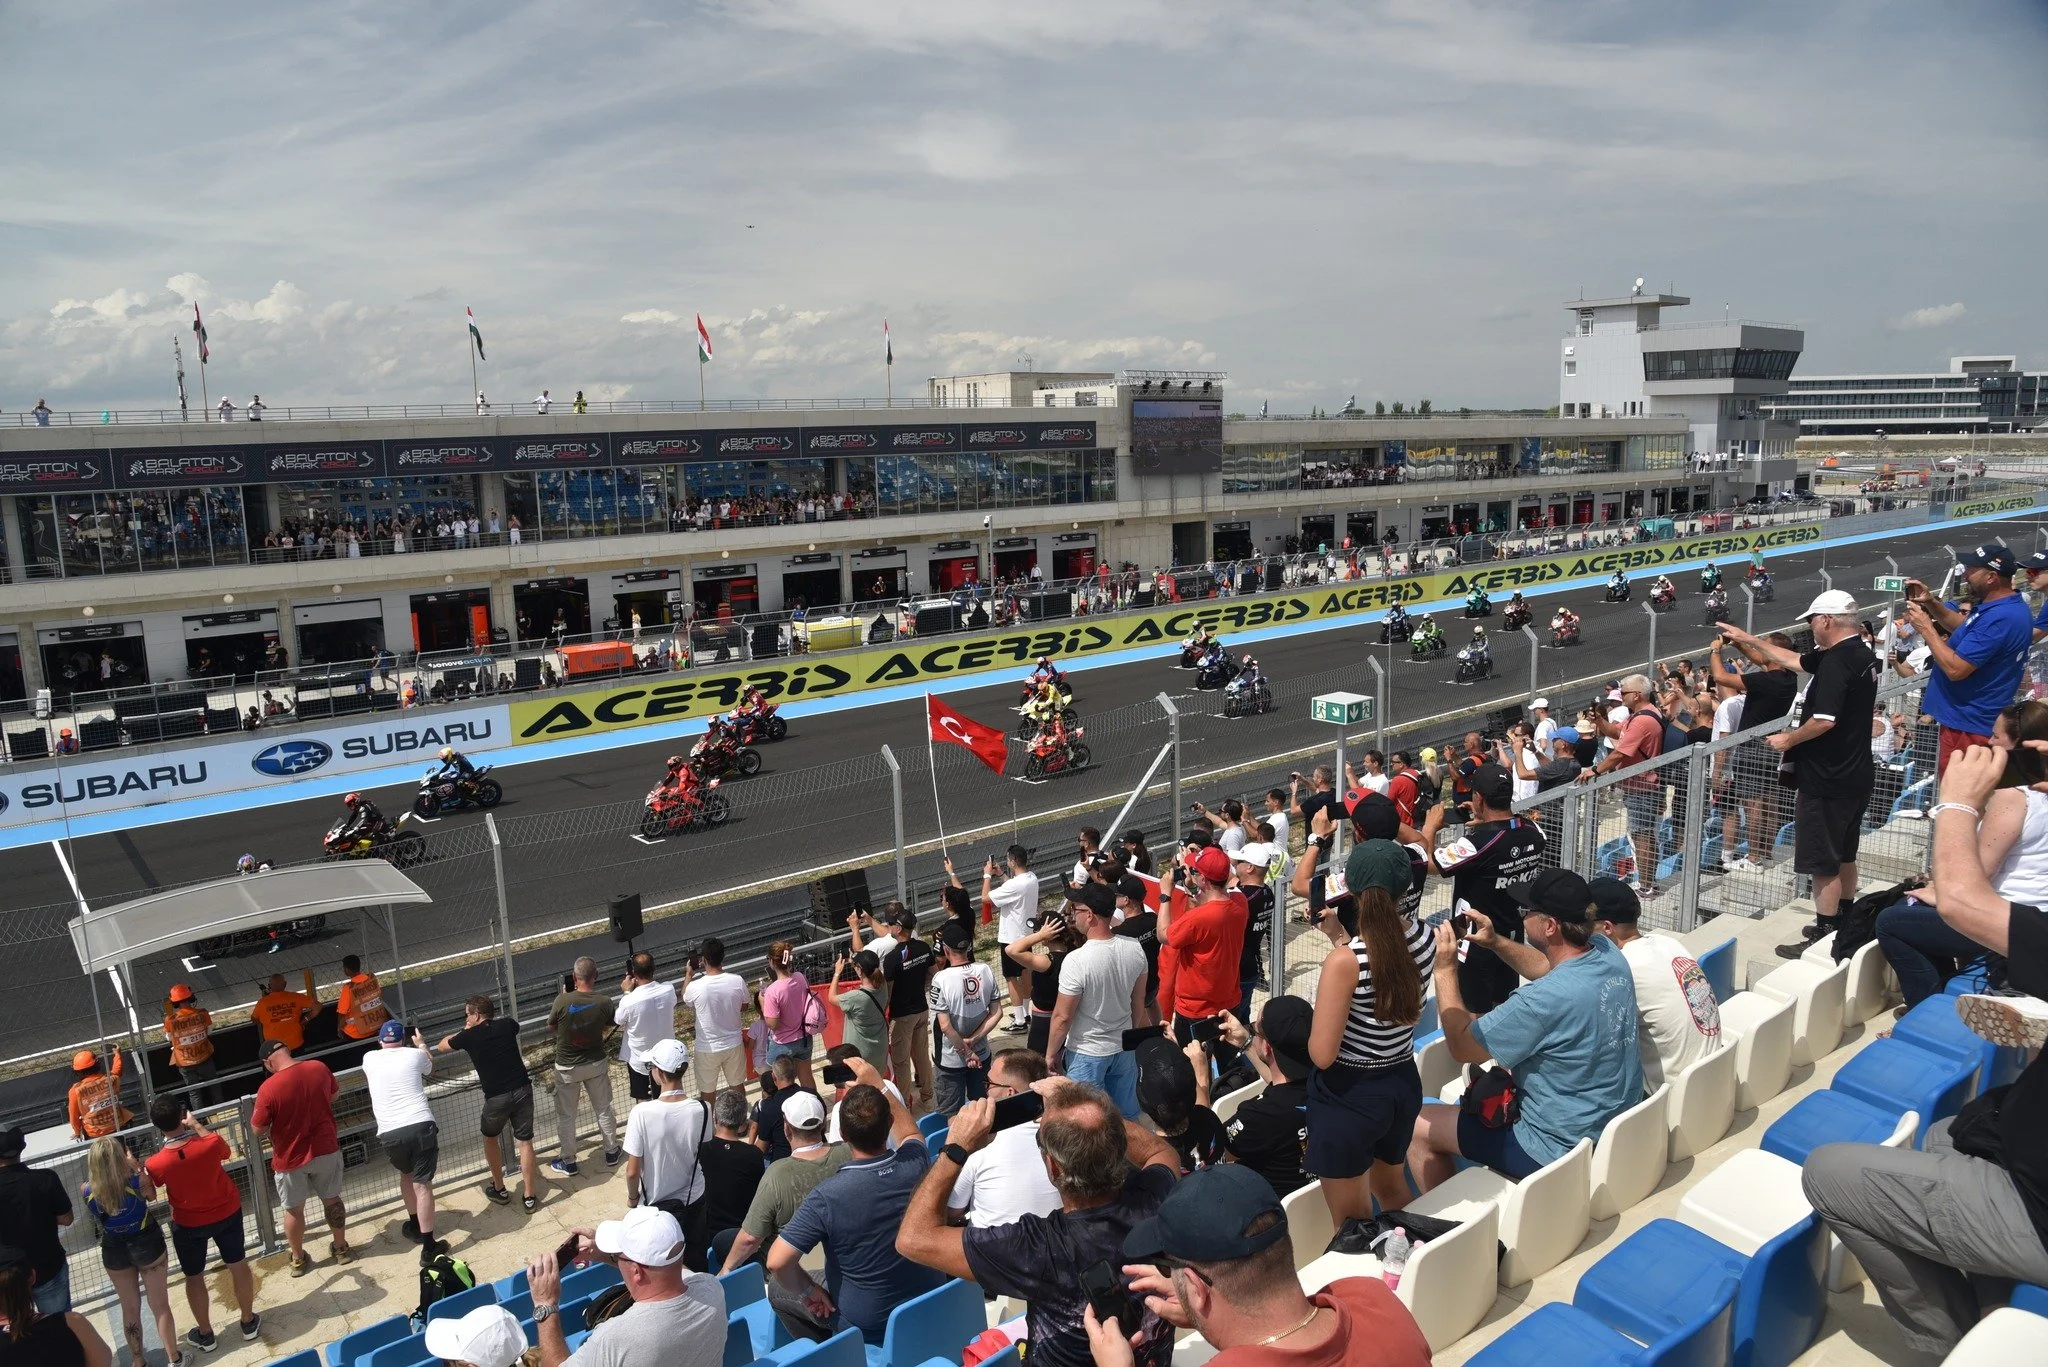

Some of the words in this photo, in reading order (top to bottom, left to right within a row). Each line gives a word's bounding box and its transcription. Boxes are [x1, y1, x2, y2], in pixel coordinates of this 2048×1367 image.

[820, 434, 866, 442] BALATON
[902, 432, 946, 440] BALATON
[632, 440, 688, 448] BALATON
[730, 436, 781, 446] BALATON
[528, 443, 588, 452] BALATON
[660, 446, 688, 454] CIRCUIT
[285, 452, 356, 462] BALATON
[412, 448, 477, 458] BALATON
[557, 450, 588, 458] CIRCUIT
[145, 457, 224, 468] BALATON
[320, 460, 358, 468] CIRCUIT
[444, 456, 478, 464] CIRCUIT
[0, 462, 78, 474] ALATON
[185, 466, 226, 475] CIRCUIT
[34, 472, 79, 480] CIRCUIT
[342, 718, 492, 759] SUBARU
[21, 761, 208, 808] SUBARU
[1600, 989, 1608, 1012] NIKE
[878, 1167, 894, 1176] BOSS
